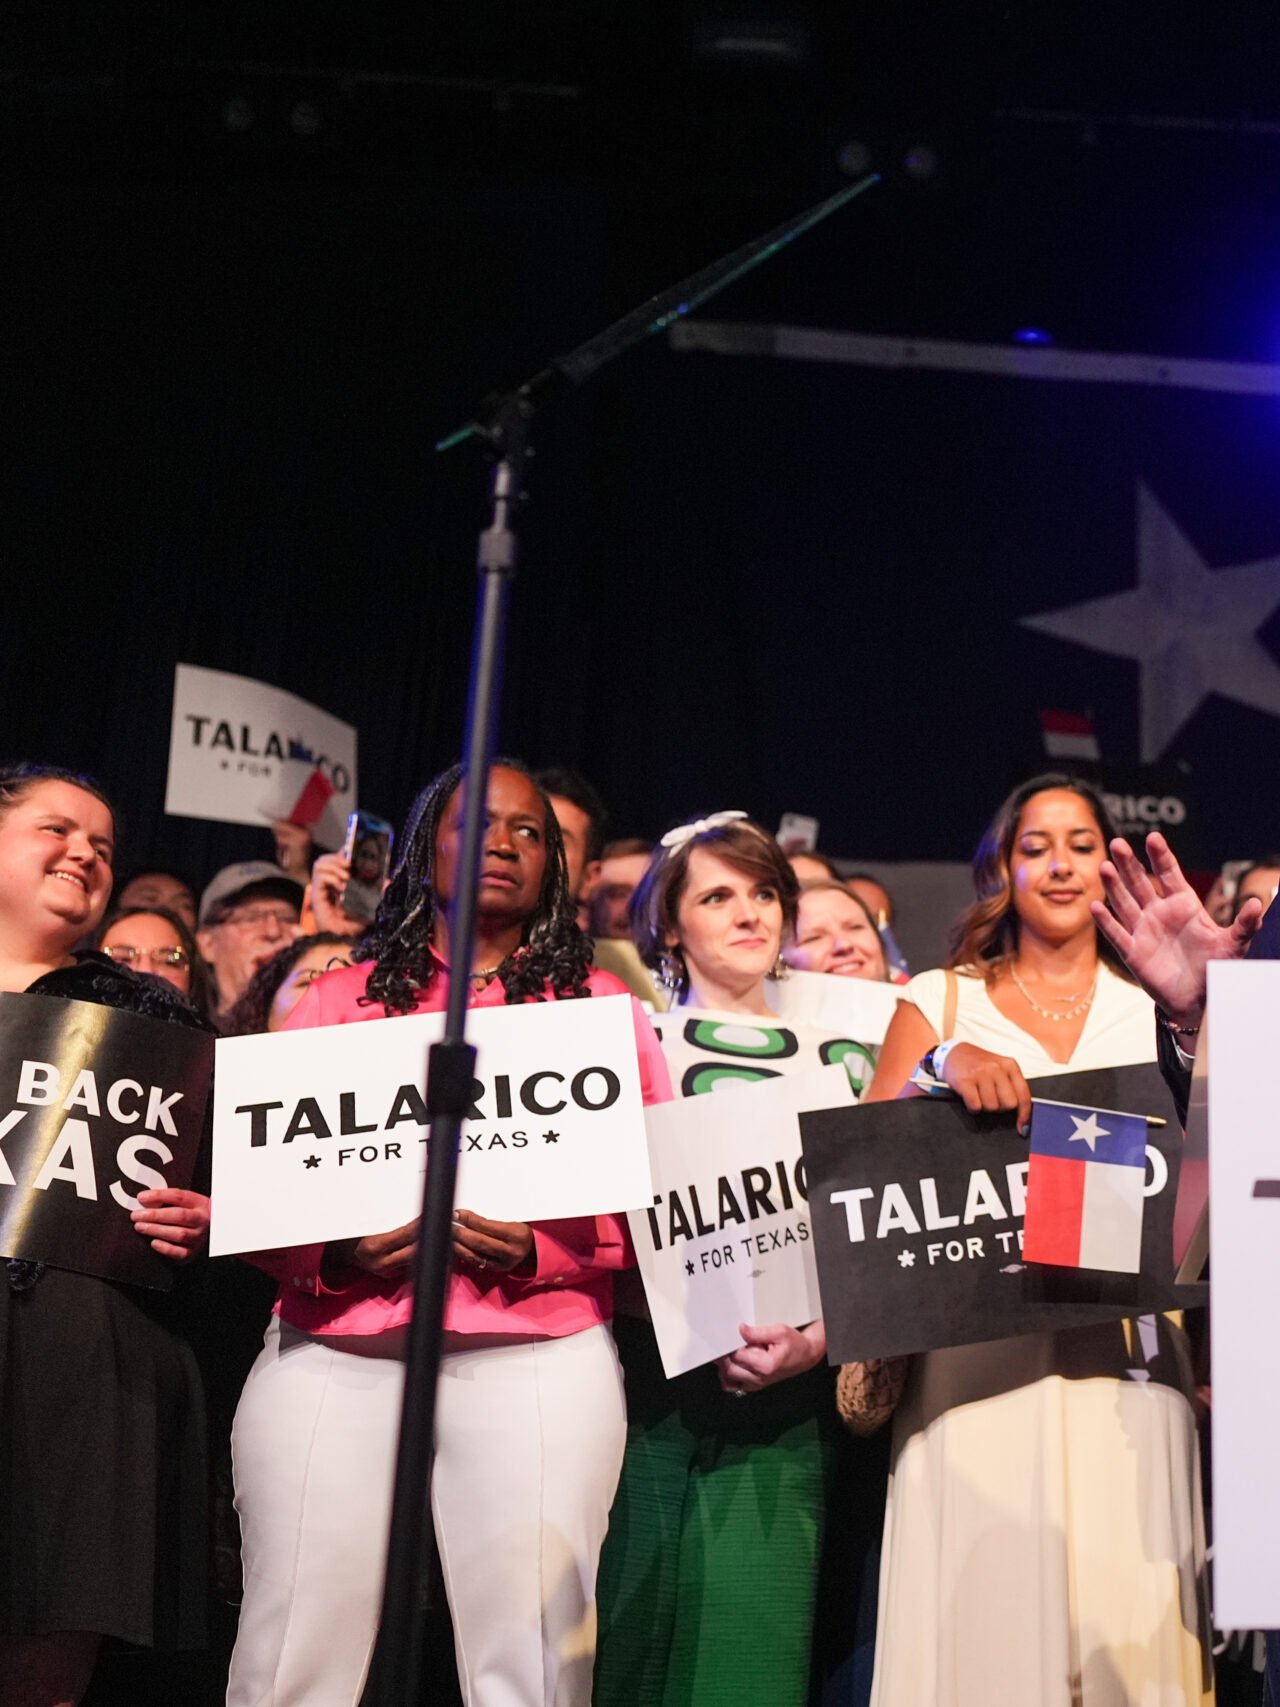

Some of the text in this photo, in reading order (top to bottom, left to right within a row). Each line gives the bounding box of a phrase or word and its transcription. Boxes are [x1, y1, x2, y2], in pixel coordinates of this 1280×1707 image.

[186, 715, 350, 795] TALAO
[16, 1060, 185, 1137] BACK
[338, 1130, 529, 1166] FOR XAS
[829, 1143, 1168, 1243] TALAO
[700, 1222, 809, 1273] FOR TEXAS
[926, 1237, 986, 1266] FOR
